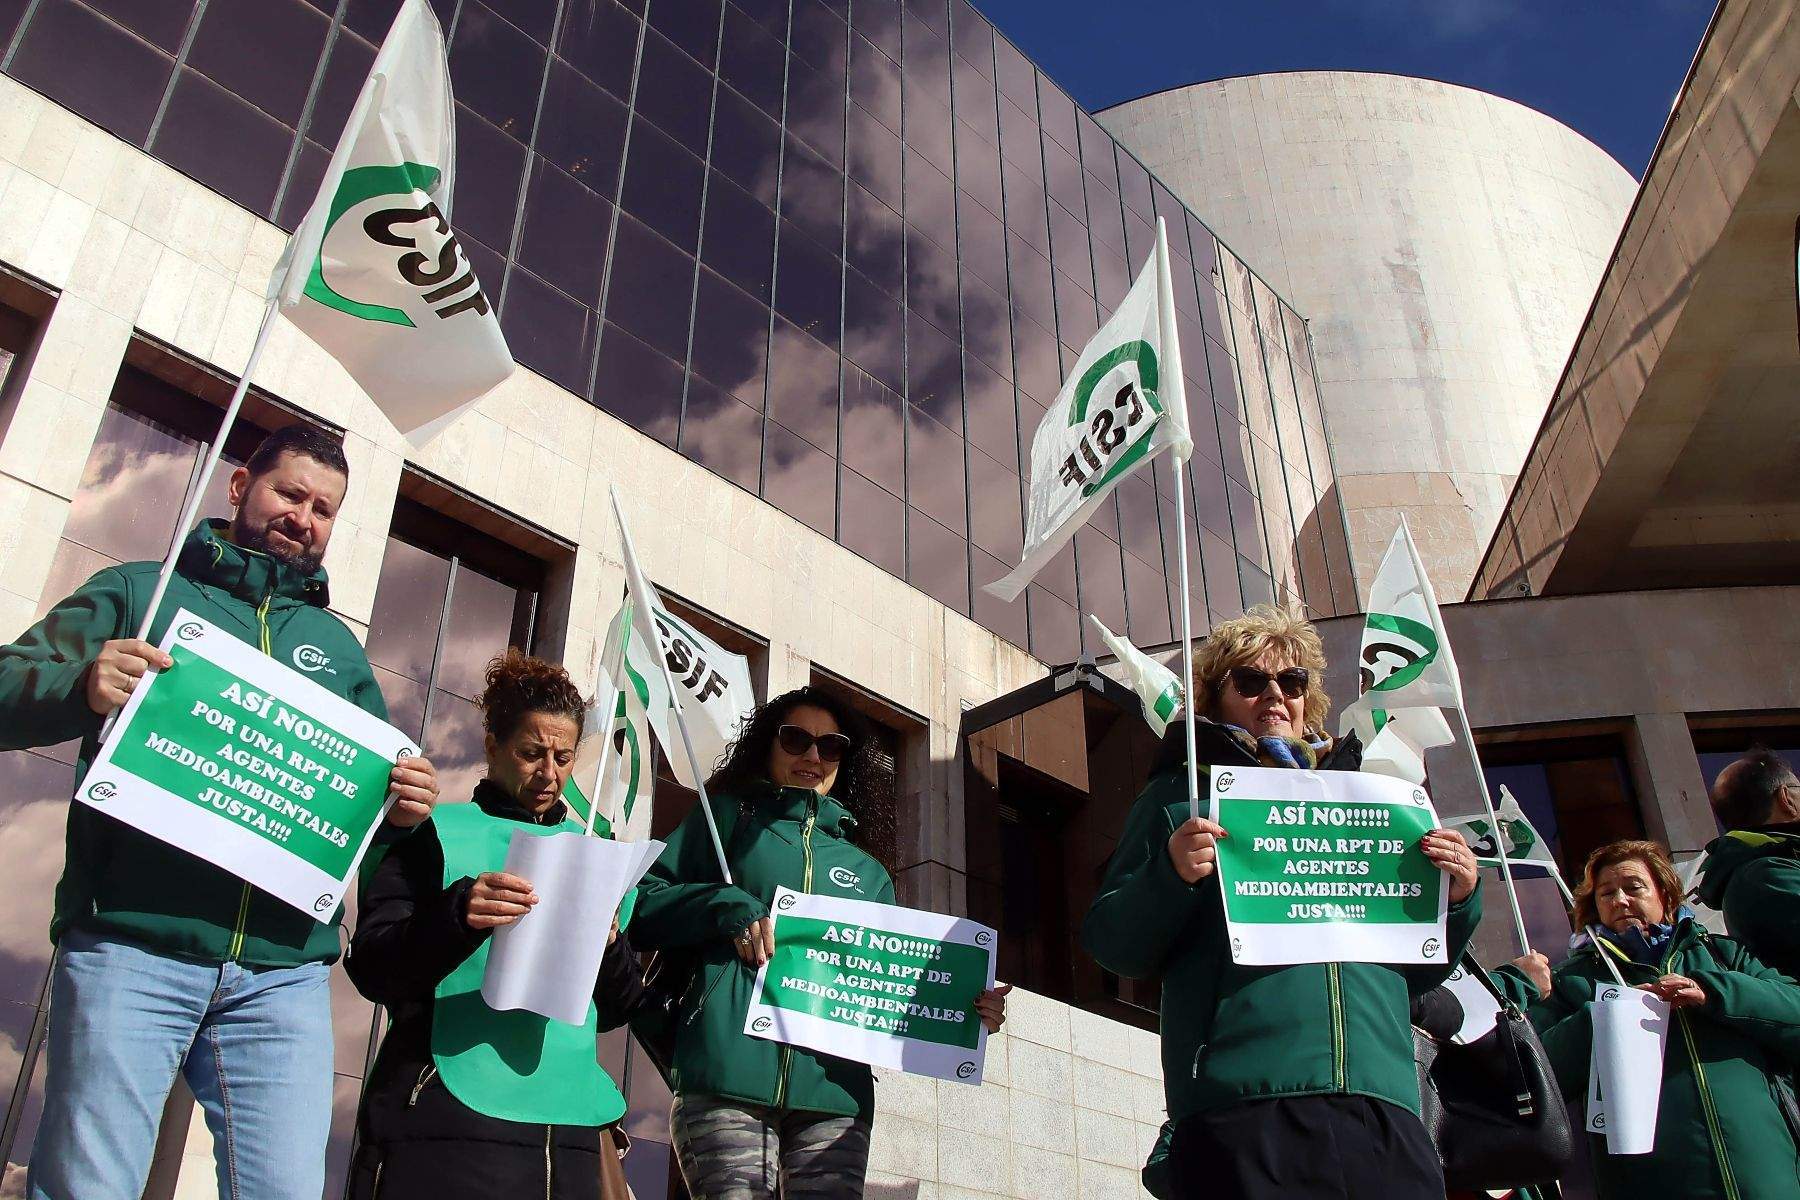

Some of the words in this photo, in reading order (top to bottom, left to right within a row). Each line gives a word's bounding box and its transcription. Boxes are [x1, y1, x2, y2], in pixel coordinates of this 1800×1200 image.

[219, 682, 276, 719] ASÍ
[273, 707, 358, 766] NO!!!!!!
[191, 699, 237, 735] POR
[240, 725, 284, 761] UNA
[287, 750, 331, 782] RPT
[329, 774, 359, 800] DE
[145, 731, 350, 848] MEDIOAMBIENTALES
[216, 742, 316, 801] AGENTES
[198, 787, 292, 842] JUSTA!!!!
[1265, 802, 1307, 826] ASÍ
[1311, 806, 1390, 828] NO!!!!!!
[1253, 837, 1288, 853] POR
[1291, 838, 1333, 853] UNA
[1335, 838, 1375, 854] RPT
[1377, 839, 1405, 855] DE
[1282, 859, 1370, 876] AGENTES
[1233, 880, 1422, 897] MEDIOAMBIENTALES
[1286, 902, 1367, 919] JUSTA!!!!
[822, 925, 865, 947] ASÍ
[867, 933, 942, 961] NO!!!!!!
[806, 948, 841, 967] POR
[846, 954, 885, 974] UNA
[887, 962, 925, 981] RPT
[926, 969, 952, 985] DE
[780, 976, 965, 1023] MEDIOAMBIENTALES
[833, 972, 917, 998] AGENTES
[829, 1006, 909, 1032] JUSTA!!!!
